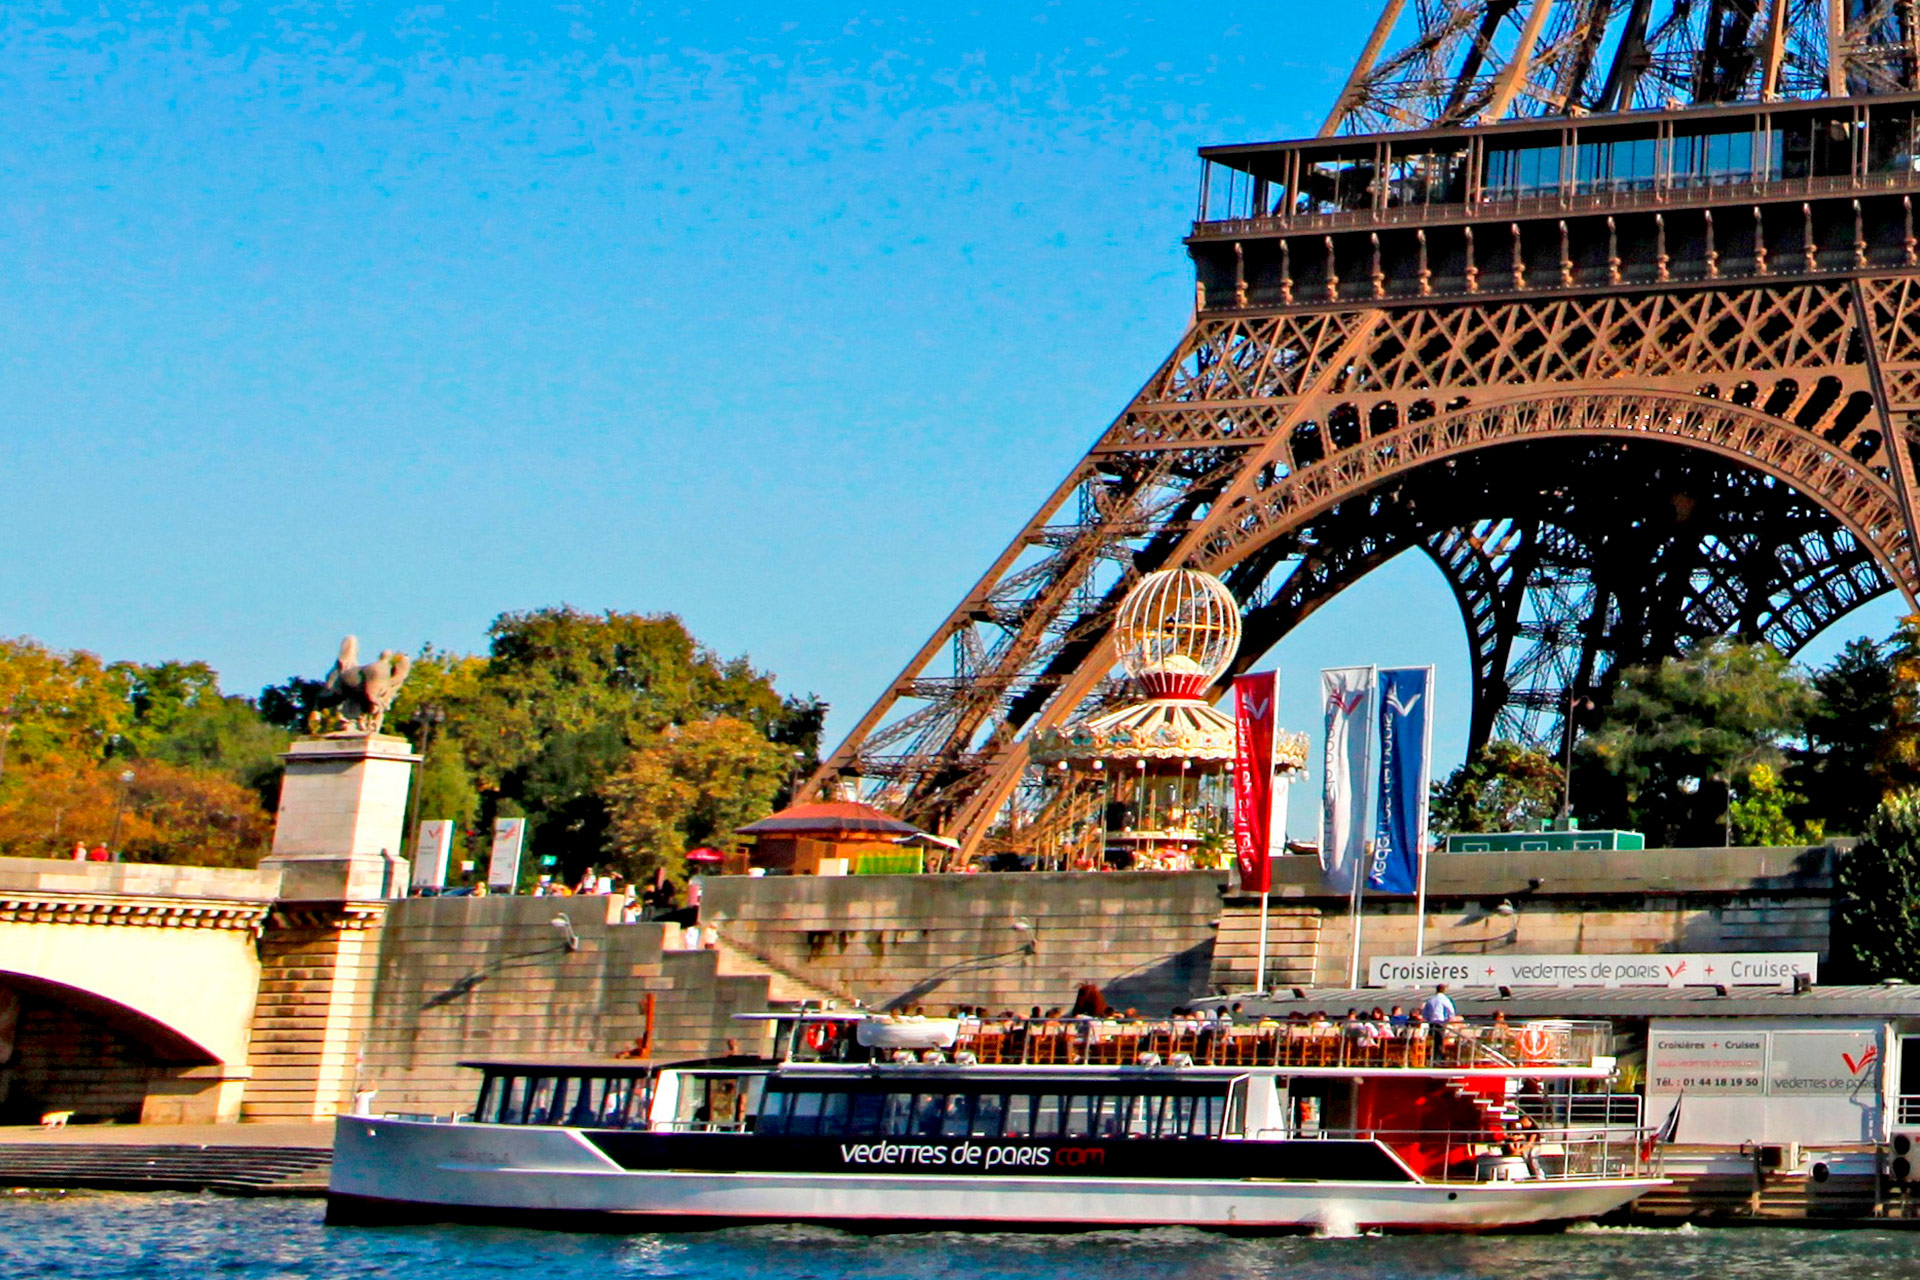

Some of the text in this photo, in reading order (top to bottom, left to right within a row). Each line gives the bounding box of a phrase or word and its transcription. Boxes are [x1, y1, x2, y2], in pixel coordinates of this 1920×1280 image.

[1379, 961, 1469, 980] Croisières
[1511, 962, 1588, 979] vedettes
[1590, 962, 1612, 979] de
[1615, 964, 1660, 981] paris
[1730, 960, 1800, 978] Cruises
[1658, 1040, 1705, 1050] Croisières
[1724, 1040, 1760, 1050] Cruises
[1683, 1078, 1695, 1087] 01
[1699, 1078, 1711, 1087] 44
[1745, 1078, 1759, 1087] 50
[1774, 1077, 1828, 1089] vedettes
[1829, 1076, 1845, 1089] de
[840, 1140, 948, 1164] vedettes
[951, 1141, 982, 1165] de
[985, 1146, 1051, 1170] paris
